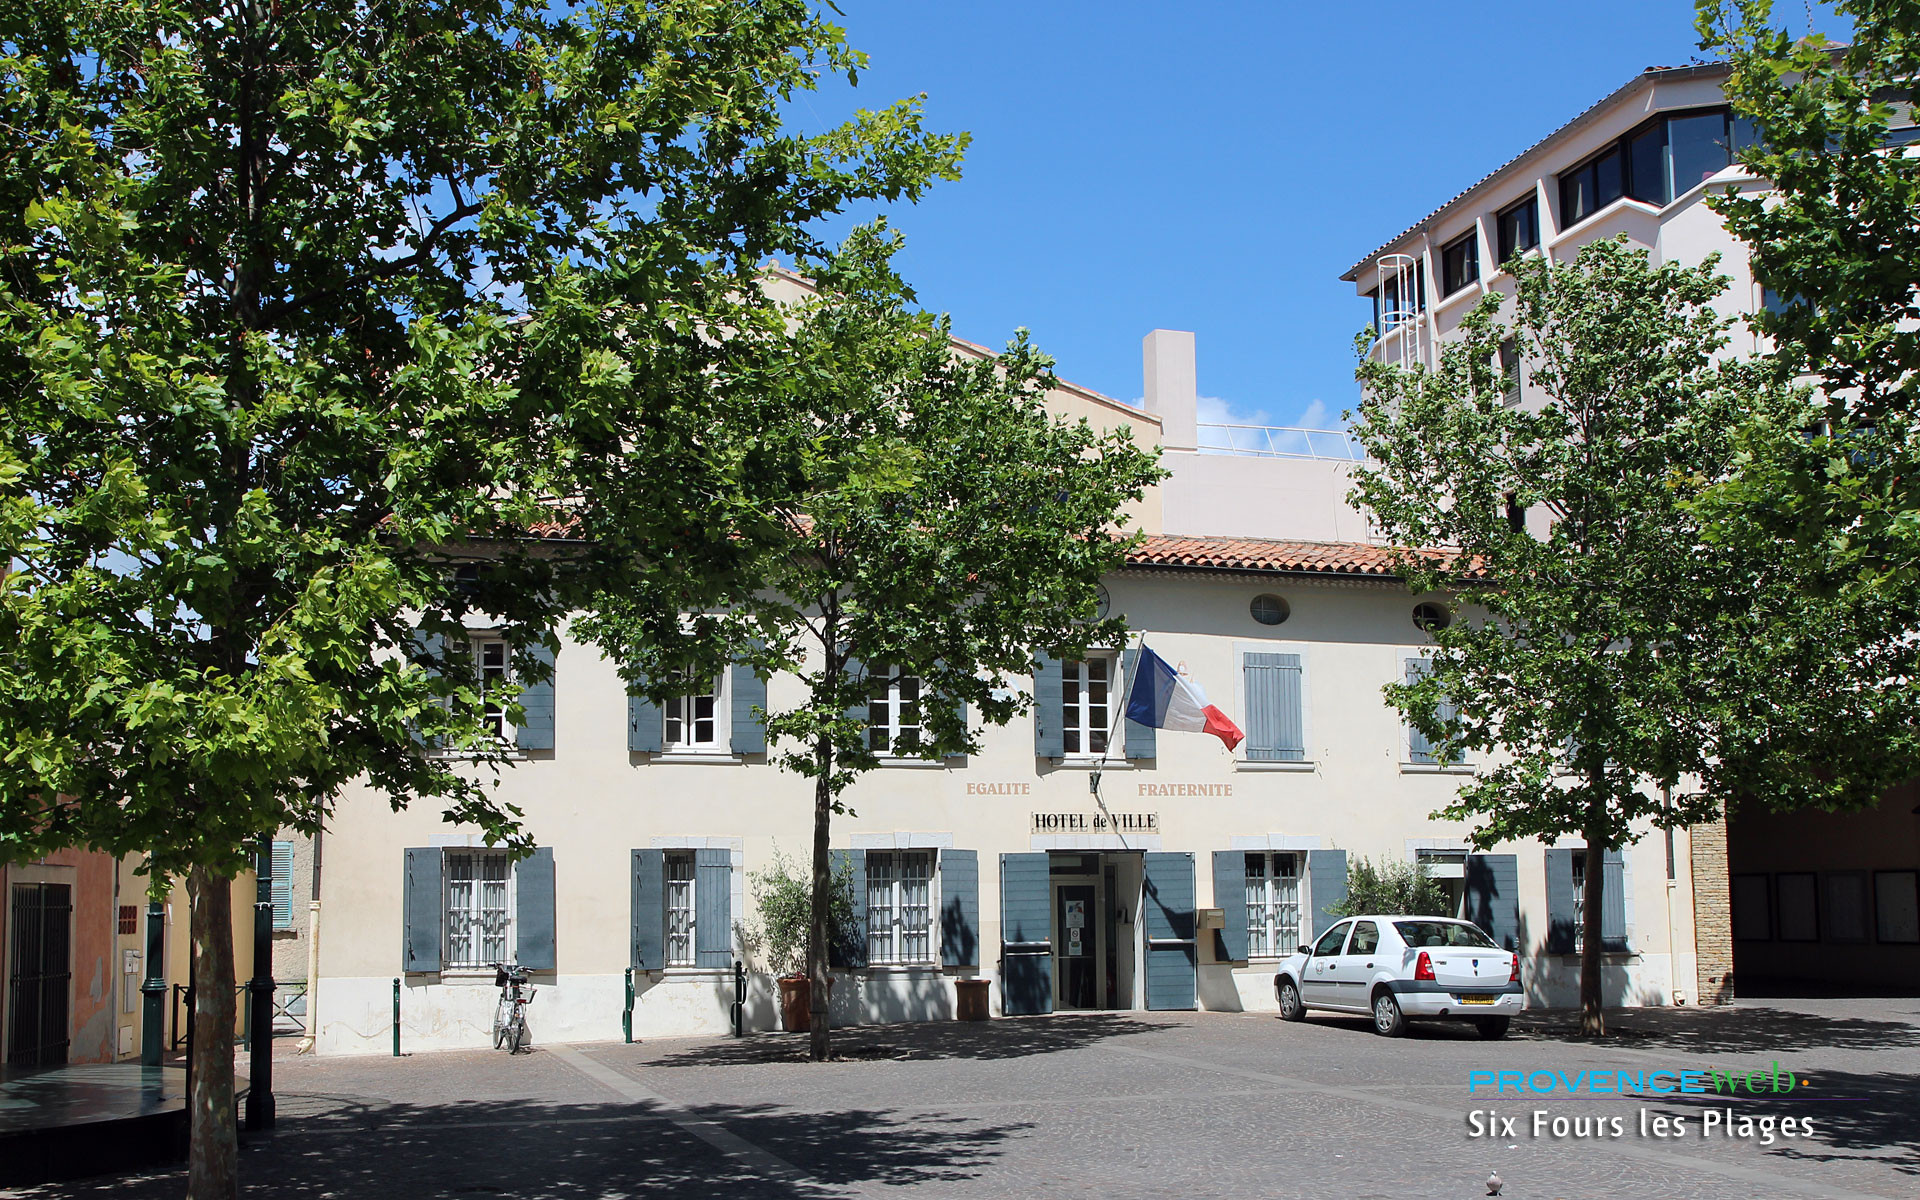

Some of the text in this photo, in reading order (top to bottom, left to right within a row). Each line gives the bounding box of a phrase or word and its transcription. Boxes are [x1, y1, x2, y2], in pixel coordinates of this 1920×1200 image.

[966, 783, 1030, 795] EGALITE
[1138, 783, 1233, 797] FRATERNITE
[1035, 814, 1157, 828] HOTEL de VILLE
